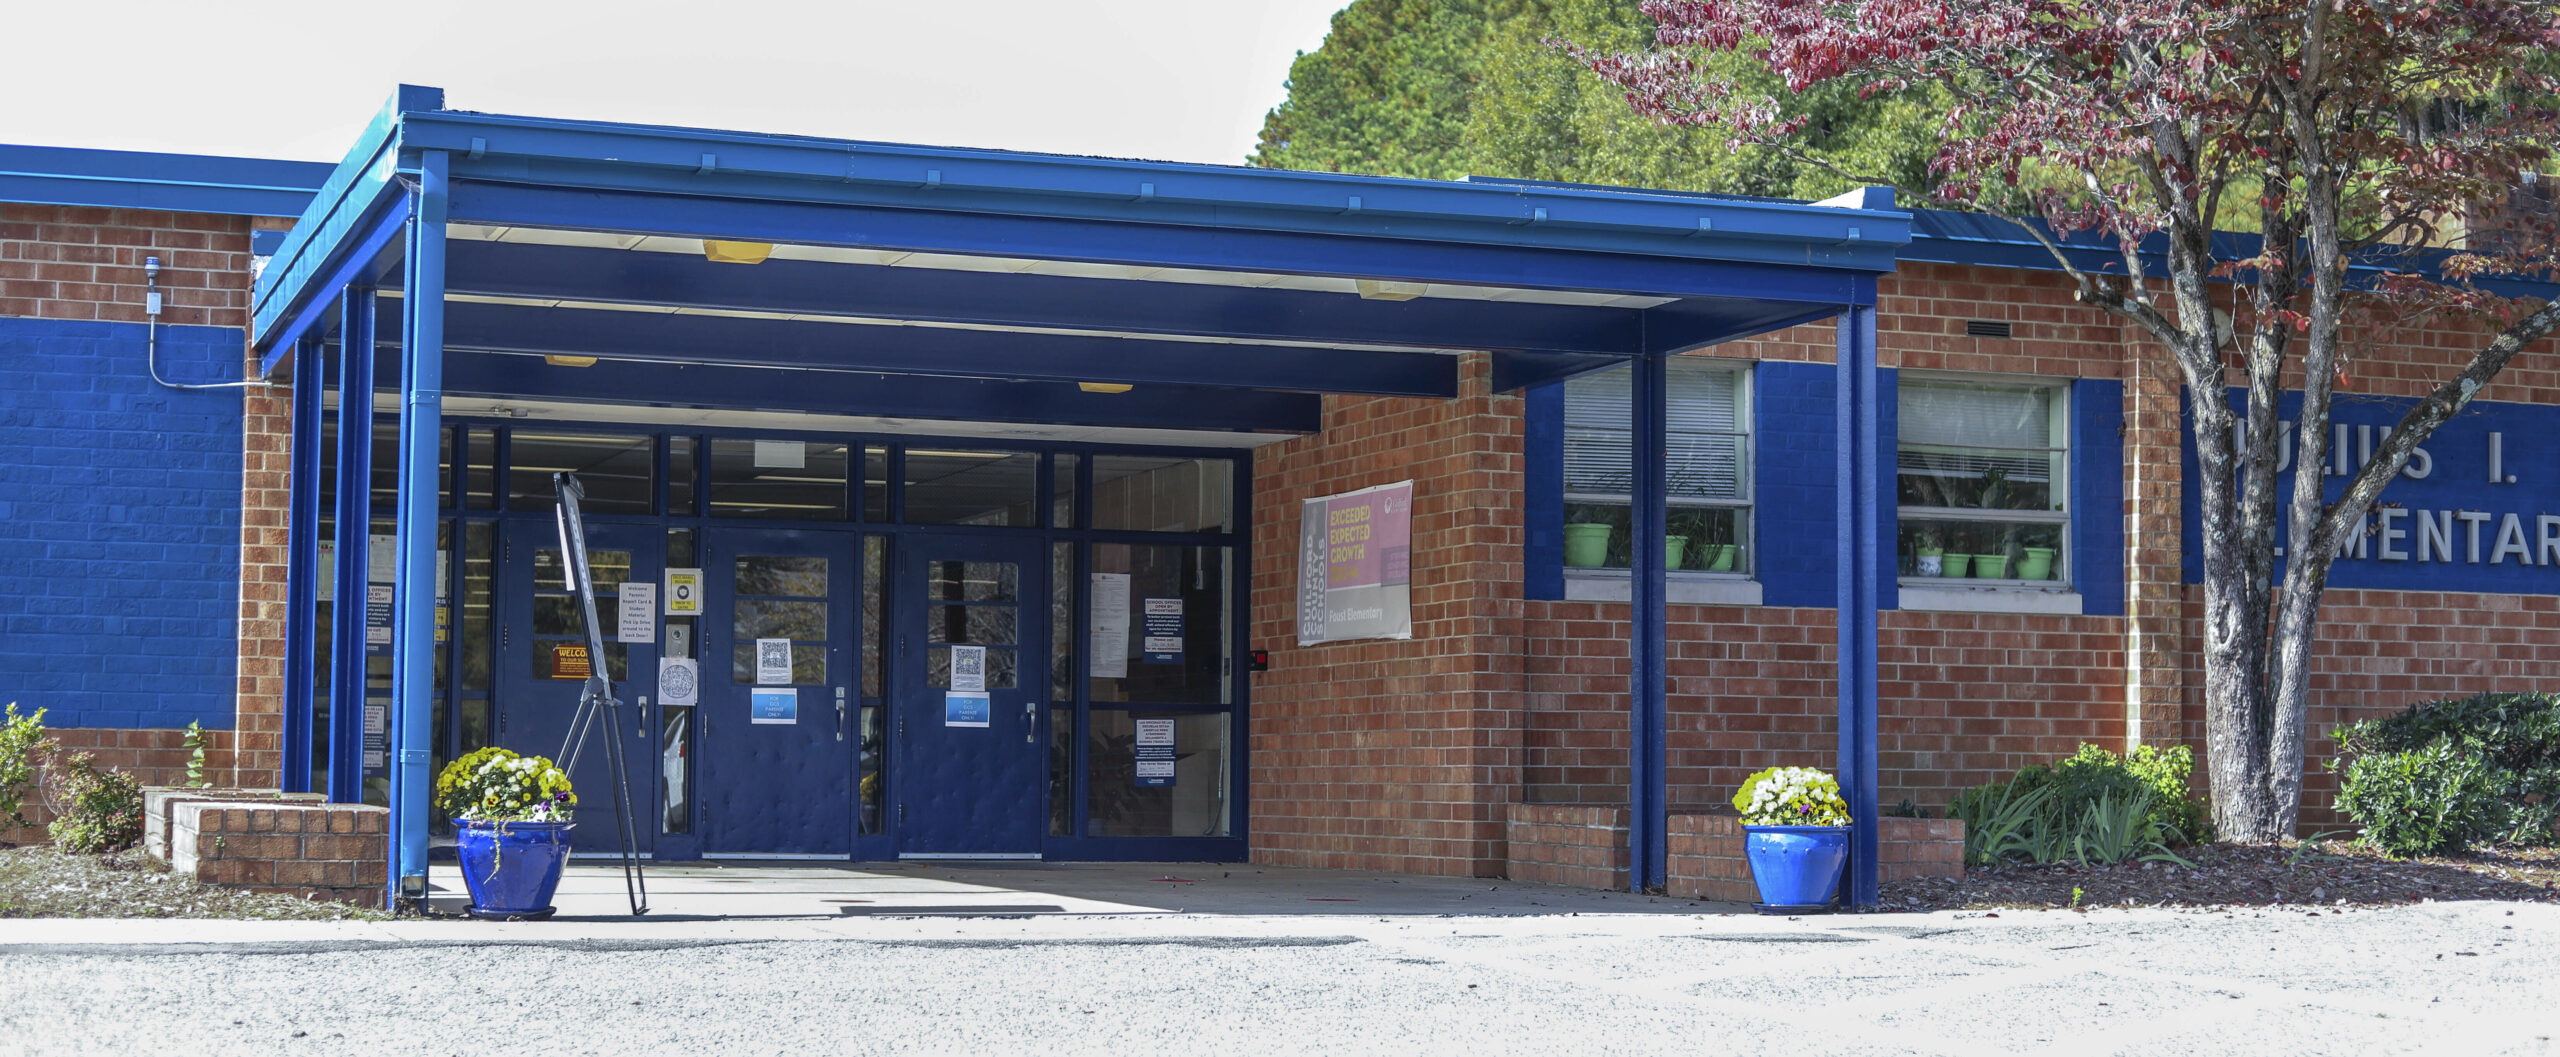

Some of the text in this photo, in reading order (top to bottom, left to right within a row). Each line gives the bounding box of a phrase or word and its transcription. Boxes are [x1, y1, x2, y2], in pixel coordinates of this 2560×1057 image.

[2232, 418, 2517, 483] JUIUS I.
[1330, 505, 1371, 526] EXCEEDED
[1330, 524, 1371, 545] EXPECTED
[1330, 543, 1365, 564] GROWTH
[1303, 535, 1313, 636] GUILFORD
[1310, 552, 1318, 636] COUNTY
[1317, 537, 1325, 635] SCHOOLS
[1329, 607, 1383, 623] Faust Elementary
[559, 649, 588, 658] WELCO
